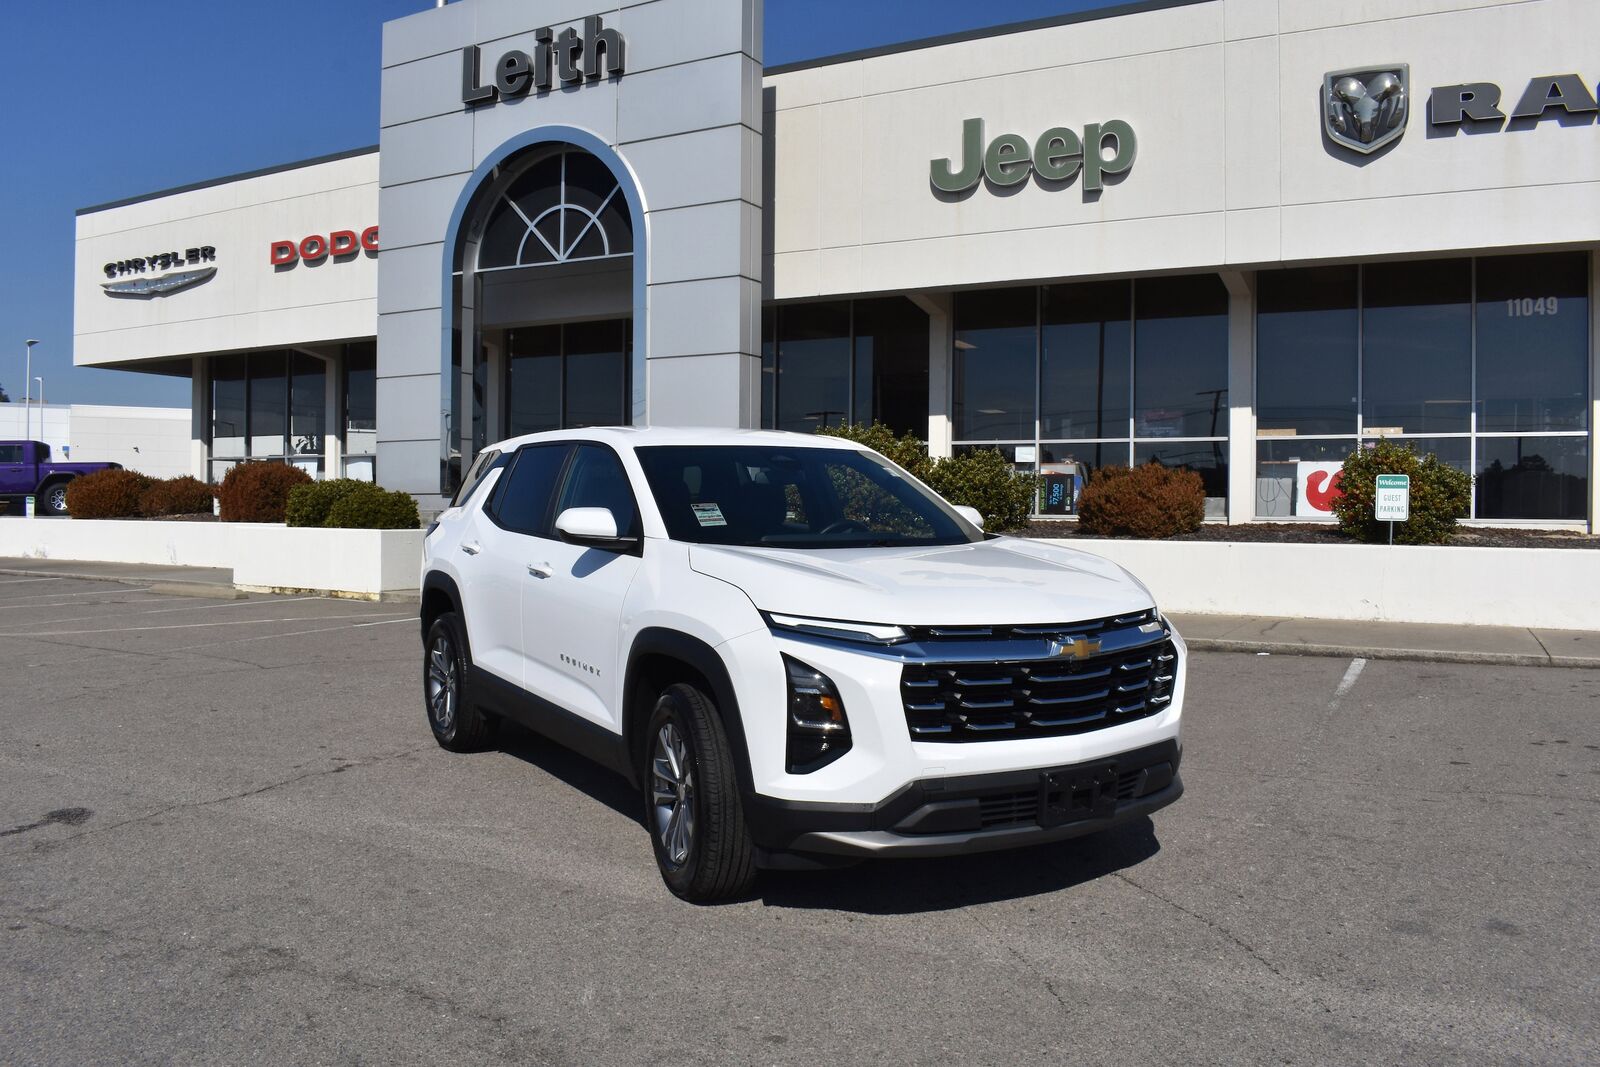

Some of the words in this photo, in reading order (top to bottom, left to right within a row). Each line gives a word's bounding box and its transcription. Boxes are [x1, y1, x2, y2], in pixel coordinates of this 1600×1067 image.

[463, 14, 625, 104] Leith
[1432, 73, 1600, 124] RA
[930, 117, 1138, 193] Jeep
[104, 246, 216, 275] CHRYSLER
[1506, 296, 1558, 316] 11049
